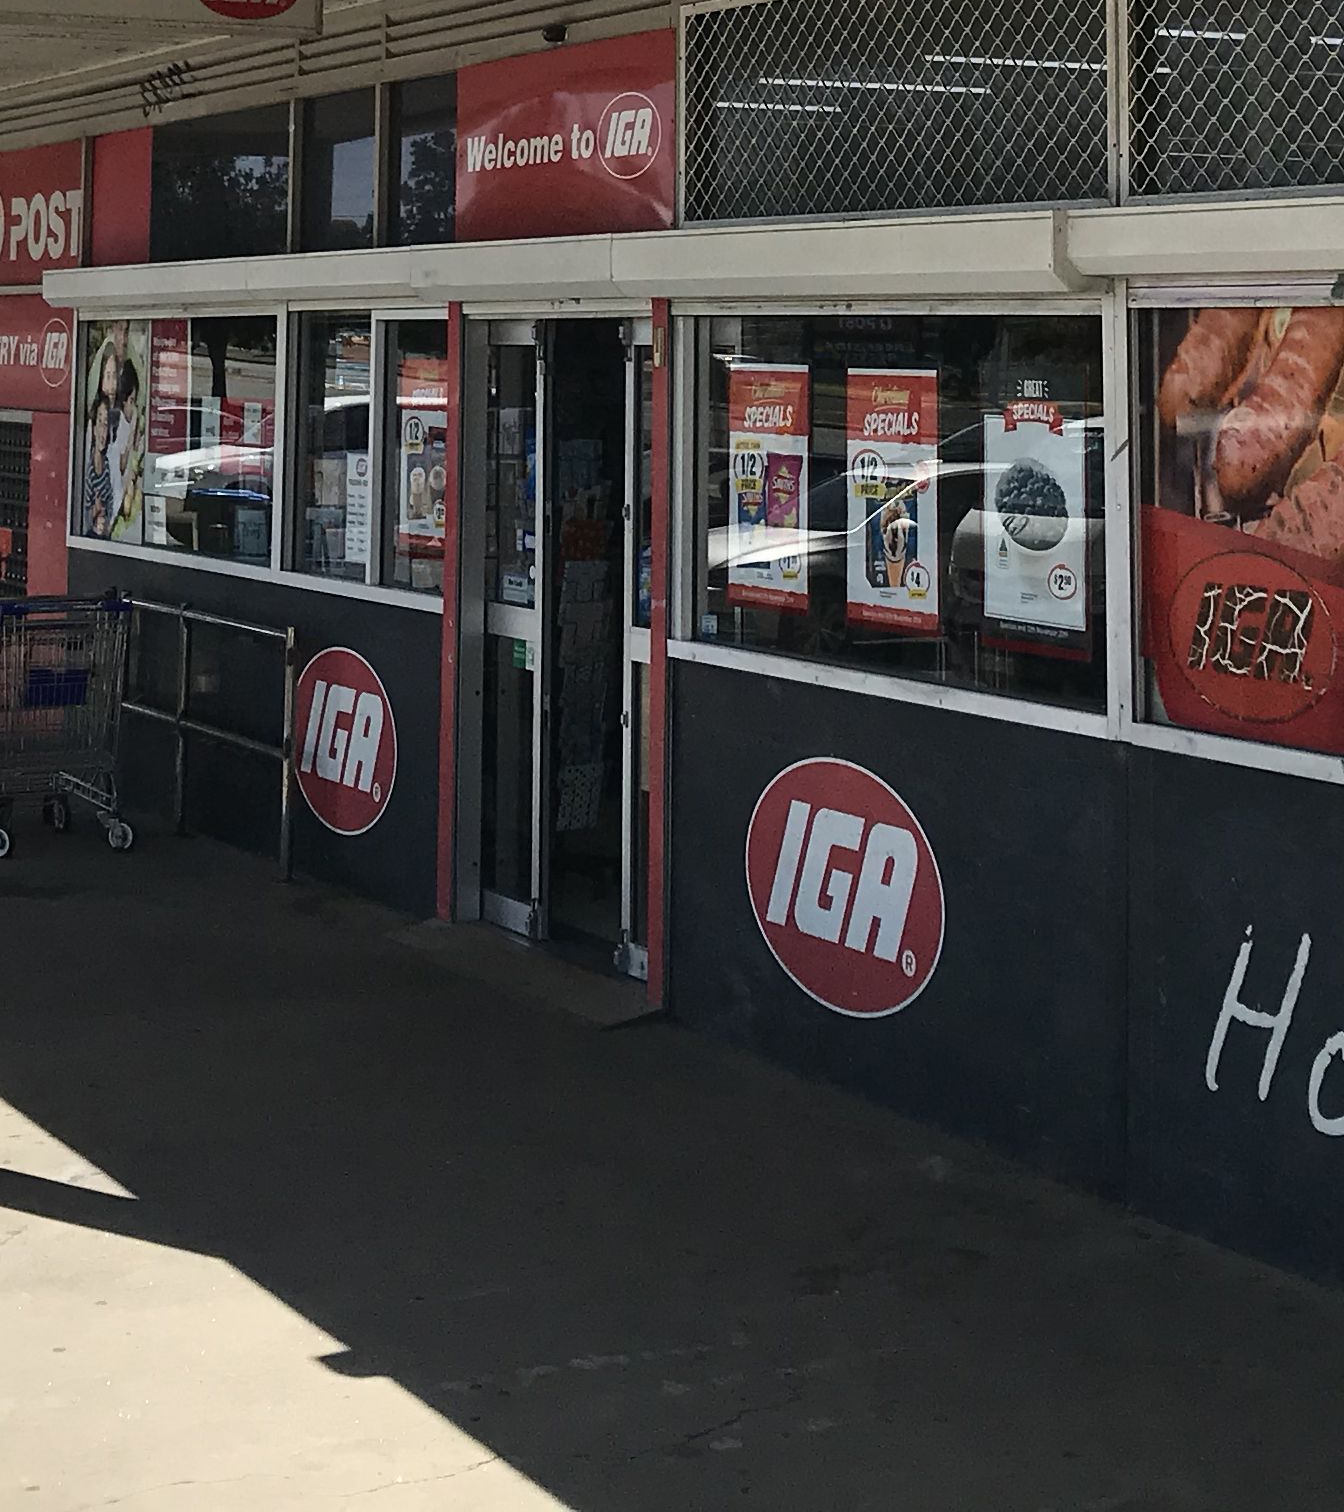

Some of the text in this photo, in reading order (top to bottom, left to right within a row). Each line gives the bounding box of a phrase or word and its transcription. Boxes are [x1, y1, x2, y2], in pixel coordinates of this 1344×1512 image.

[467, 107, 653, 173] Welcome to IGA
[9, 188, 84, 262] POST
[19, 335, 39, 367] via
[42, 332, 68, 369] IGA
[1023, 380, 1043, 398] GREAT
[743, 405, 793, 428] SPECIALS
[863, 411, 919, 436] SPECIALS
[1012, 402, 1055, 423] SPECIALS
[740, 452, 757, 476] 1/2
[859, 455, 878, 482] 1/2
[300, 679, 384, 795] IGA
[765, 798, 919, 964] IGA
